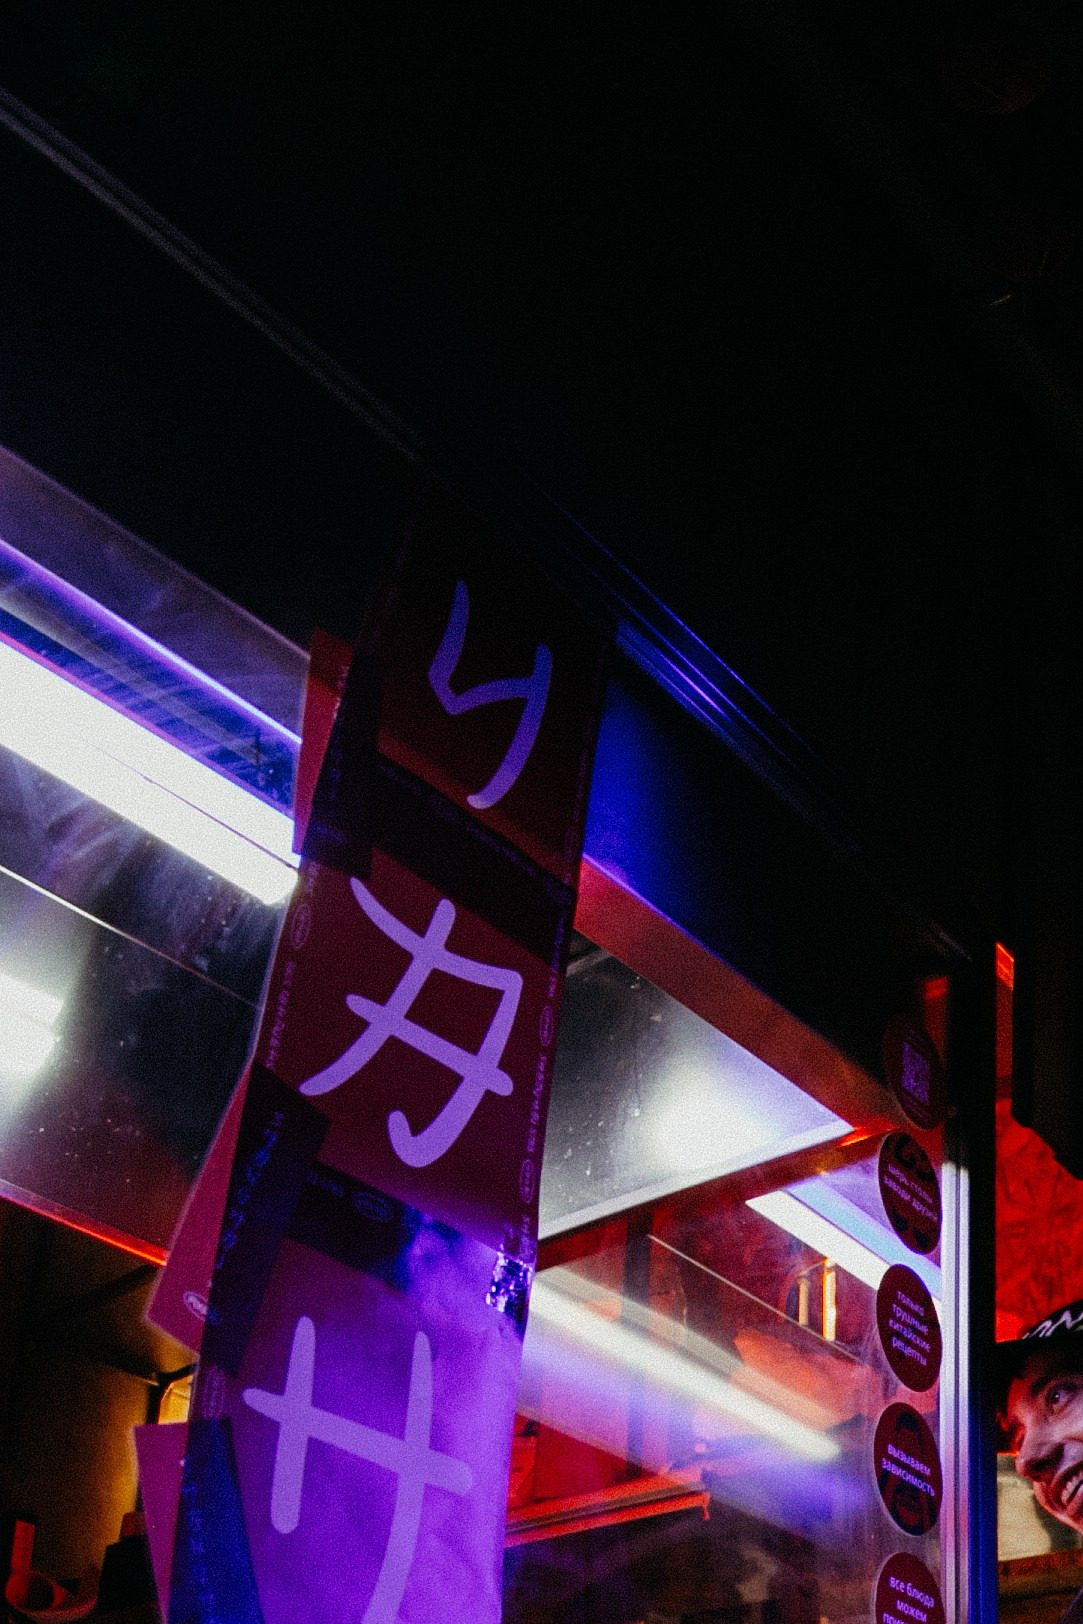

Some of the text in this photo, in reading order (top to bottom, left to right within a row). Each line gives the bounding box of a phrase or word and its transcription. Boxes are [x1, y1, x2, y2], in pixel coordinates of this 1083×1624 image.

[881, 1457, 936, 1497] зависимость
[889, 1576, 935, 1609] все блюда
[896, 1599, 928, 1624] можем
